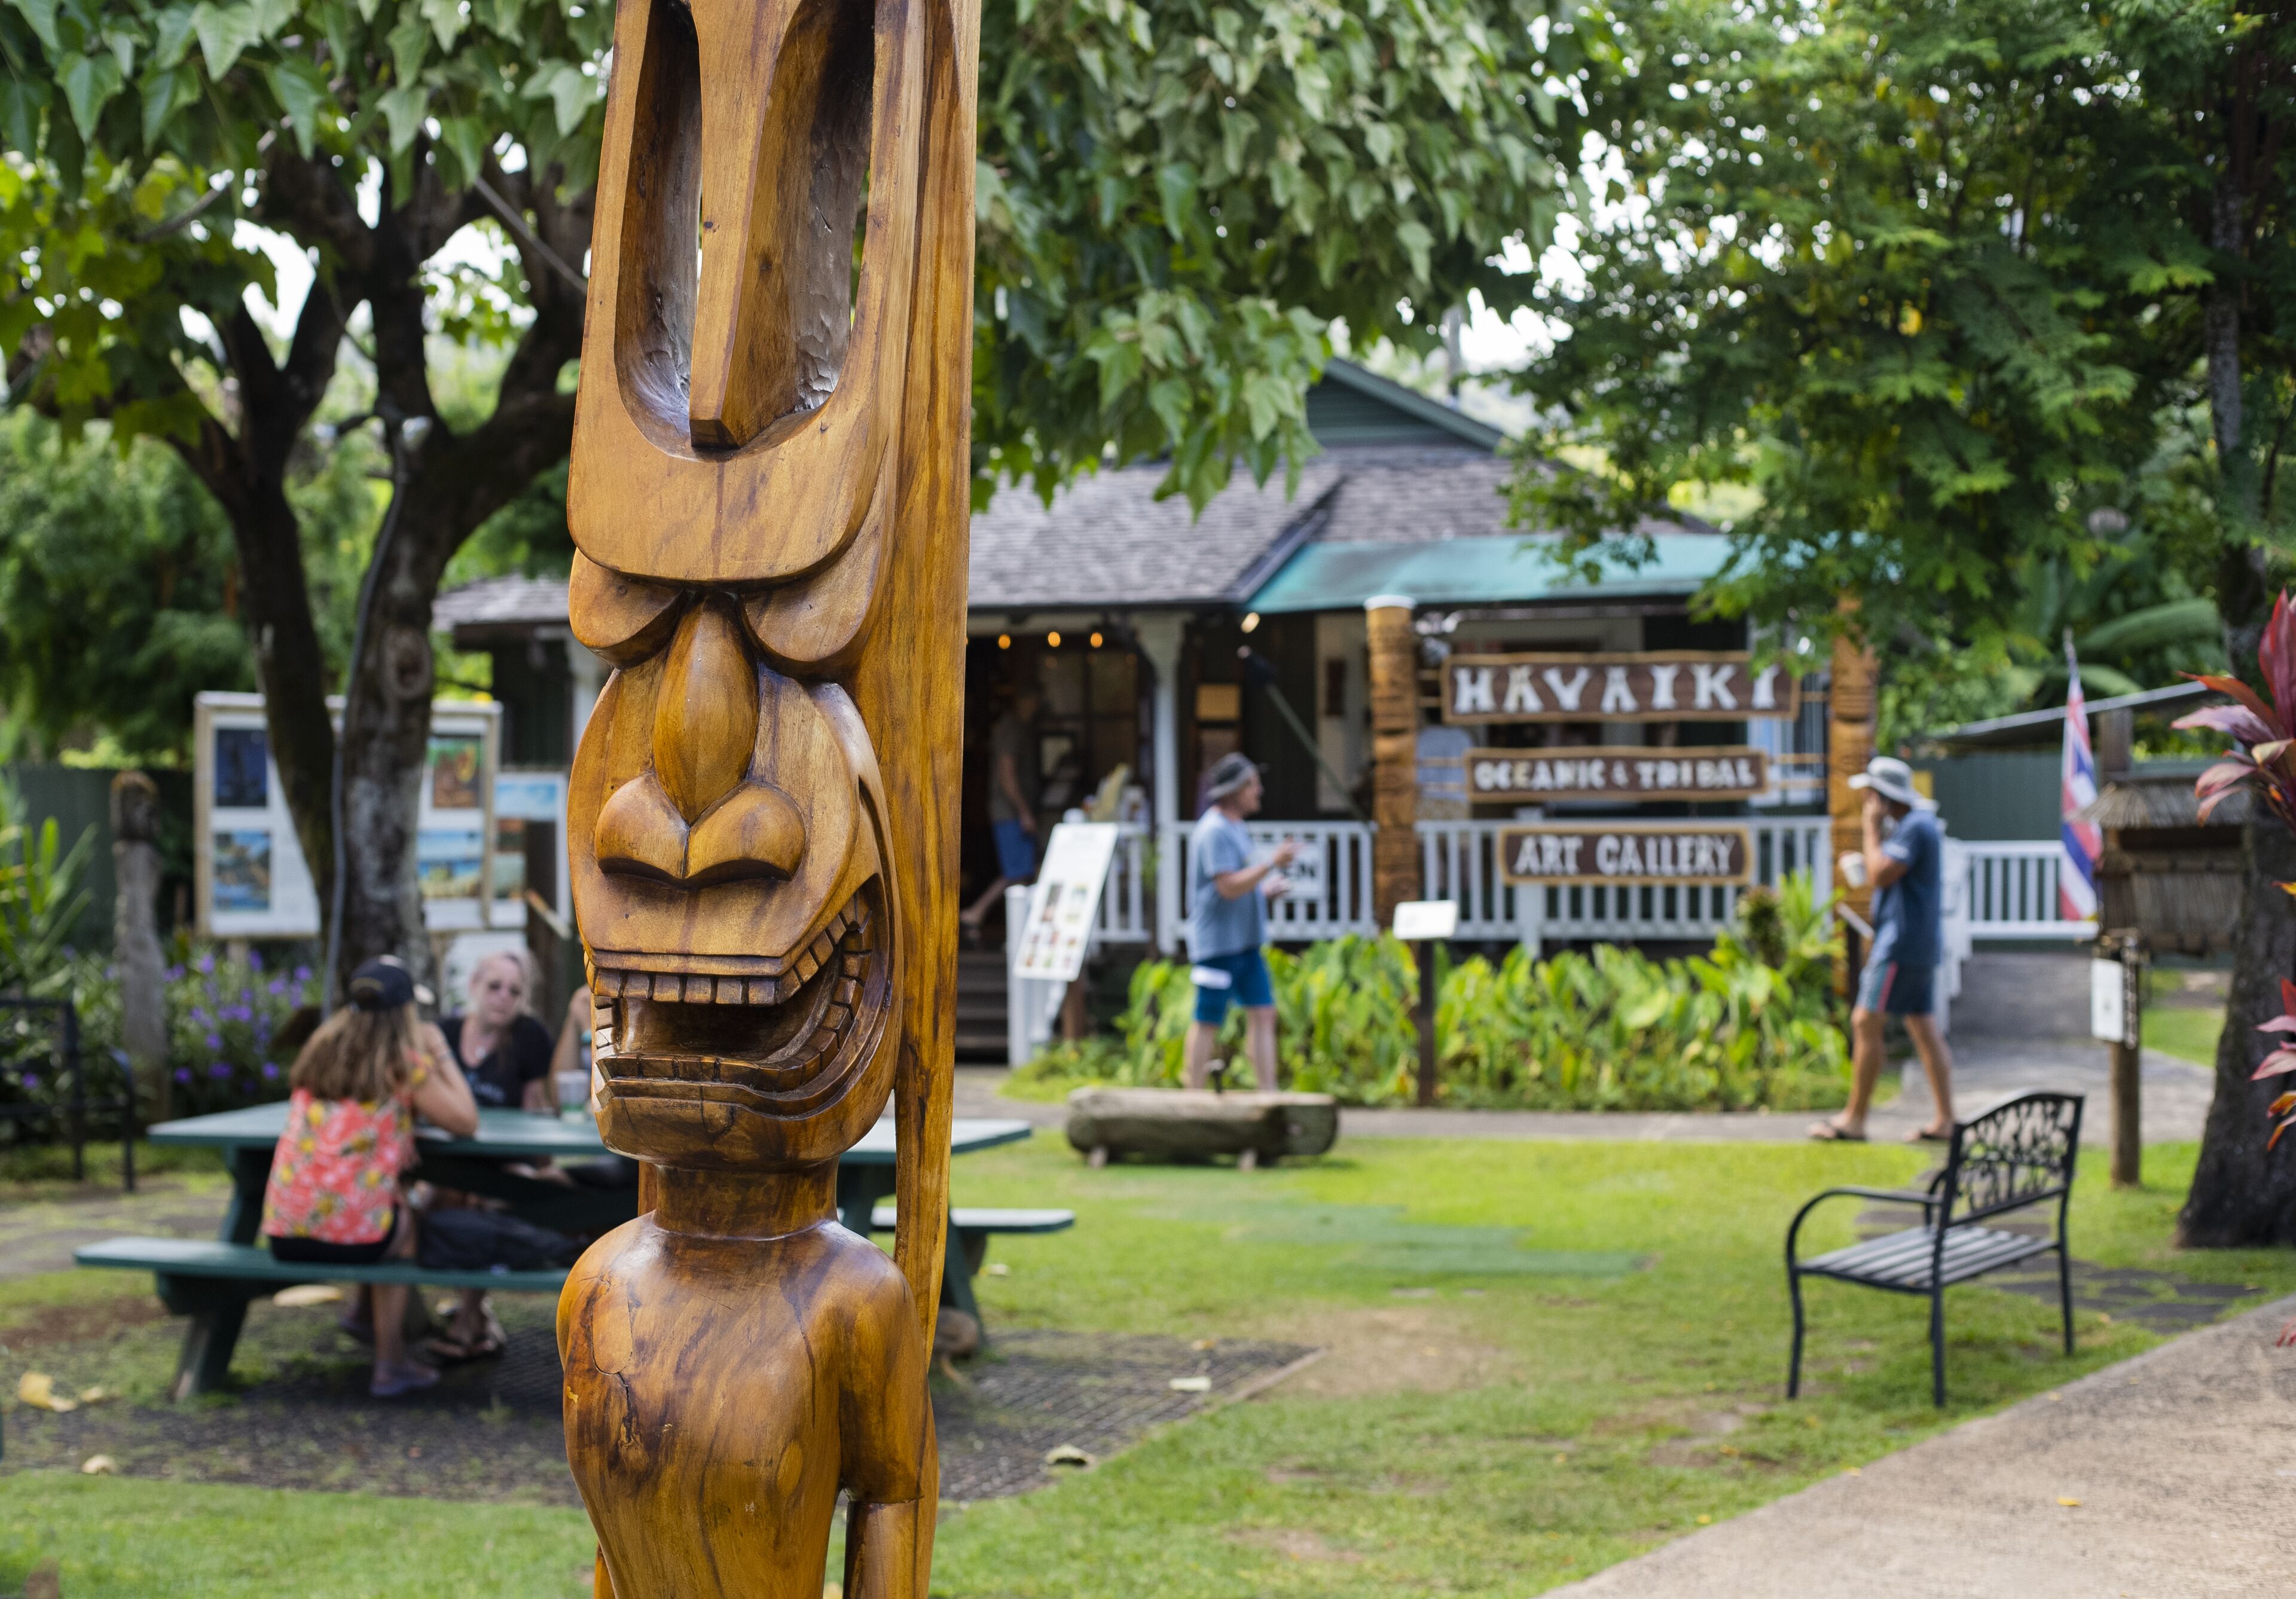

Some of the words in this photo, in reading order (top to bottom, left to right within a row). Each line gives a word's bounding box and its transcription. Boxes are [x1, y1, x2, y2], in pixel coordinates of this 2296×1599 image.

[1455, 663, 1780, 714] HAVAIKI
[1473, 759, 1606, 791] OCEANIC
[1613, 759, 1629, 788] &
[1634, 758, 1756, 790] TRIBAL
[1514, 834, 1583, 876] ART
[1595, 833, 1735, 876] GALLERY
